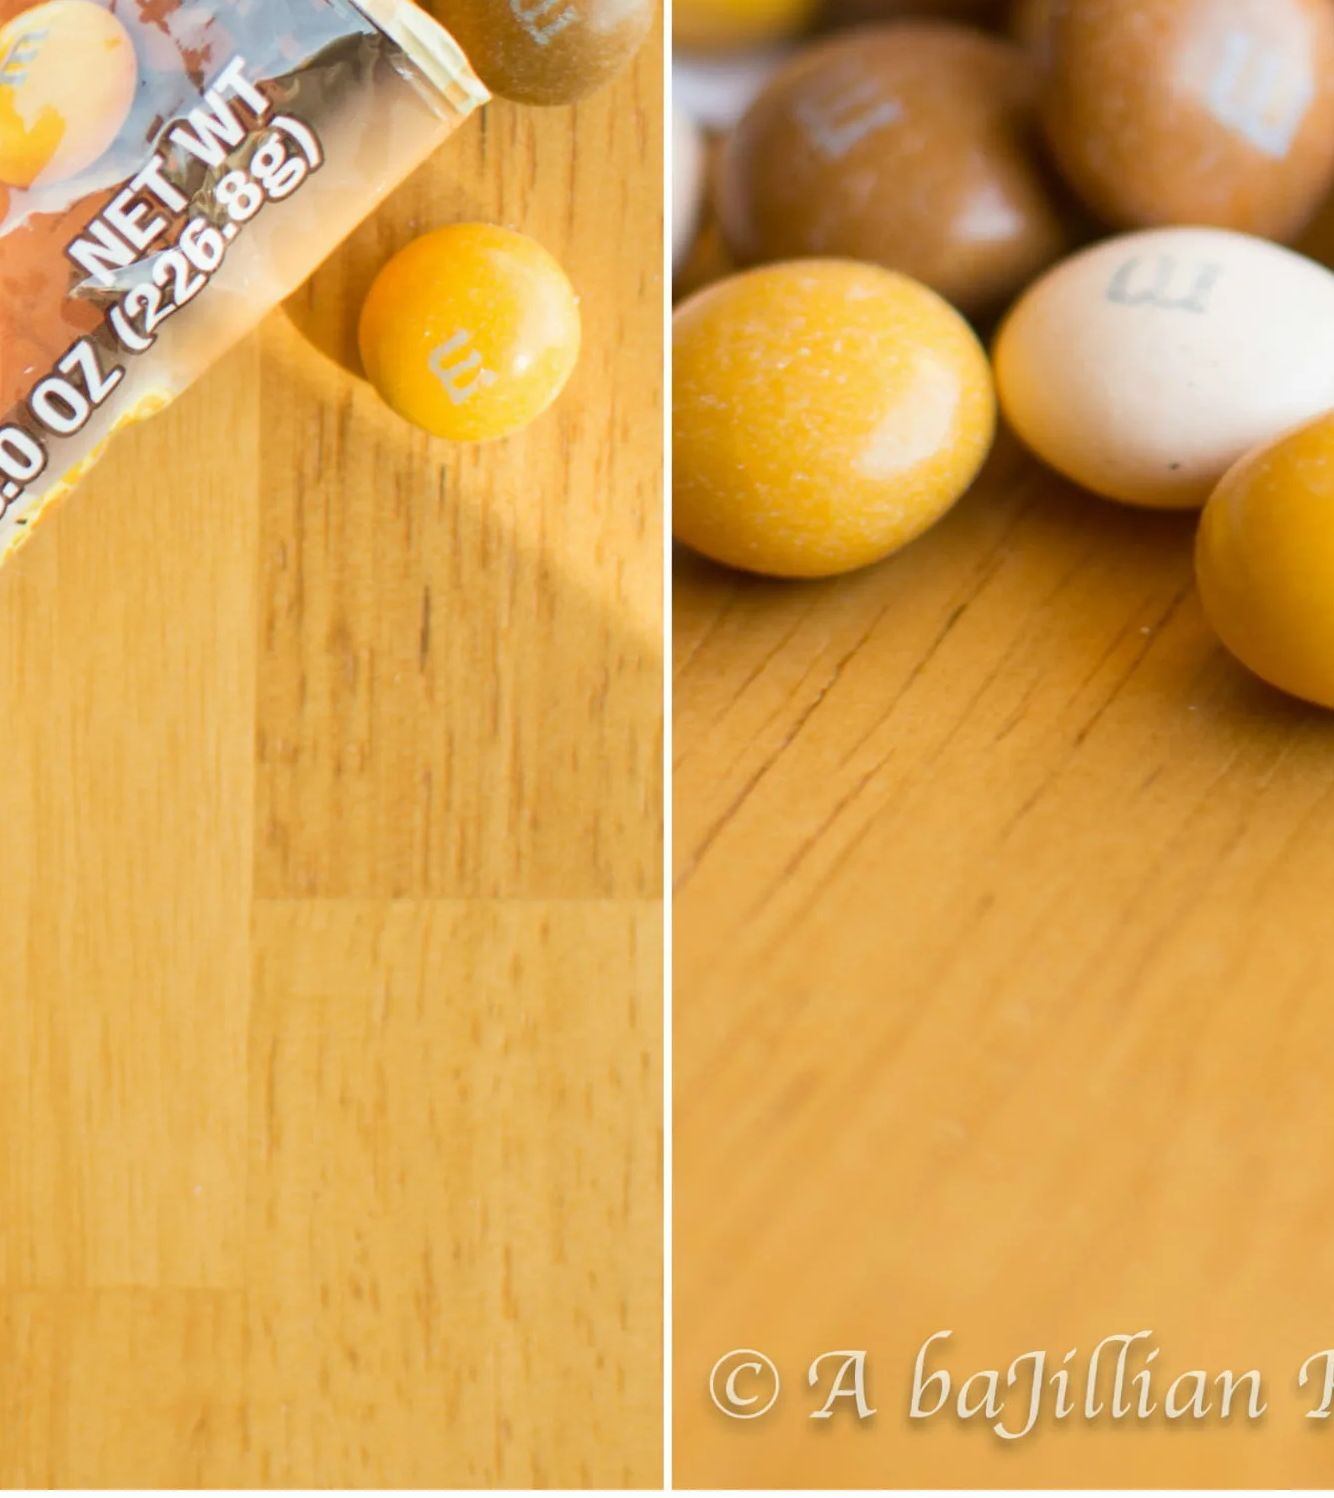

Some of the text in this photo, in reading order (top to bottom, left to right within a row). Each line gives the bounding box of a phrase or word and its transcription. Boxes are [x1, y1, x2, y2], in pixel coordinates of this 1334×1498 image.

[31, 341, 124, 435] OZ
[108, 114, 323, 353] (226.8g)
[68, 56, 270, 285] NET WT
[427, 326, 497, 407] m
